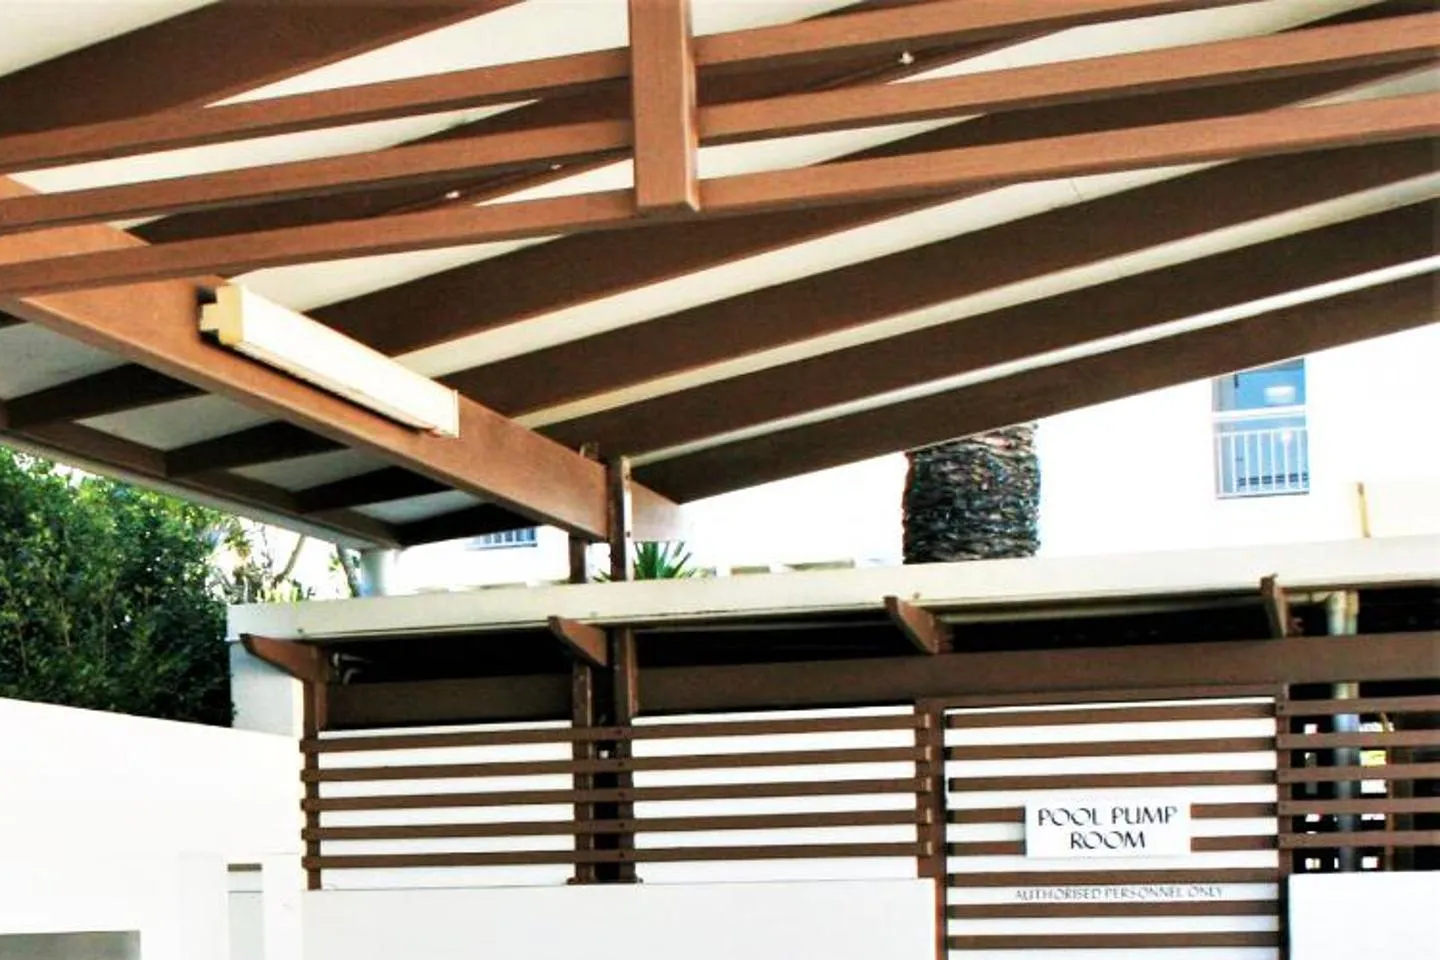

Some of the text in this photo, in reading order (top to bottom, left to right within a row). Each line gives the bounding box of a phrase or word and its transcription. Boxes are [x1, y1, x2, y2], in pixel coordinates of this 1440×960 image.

[1038, 806, 1178, 826] POOL PUMP
[1070, 831, 1146, 849] ROOM
[1016, 886, 1223, 900] AUTHORISED PERSONNEL ONLY
